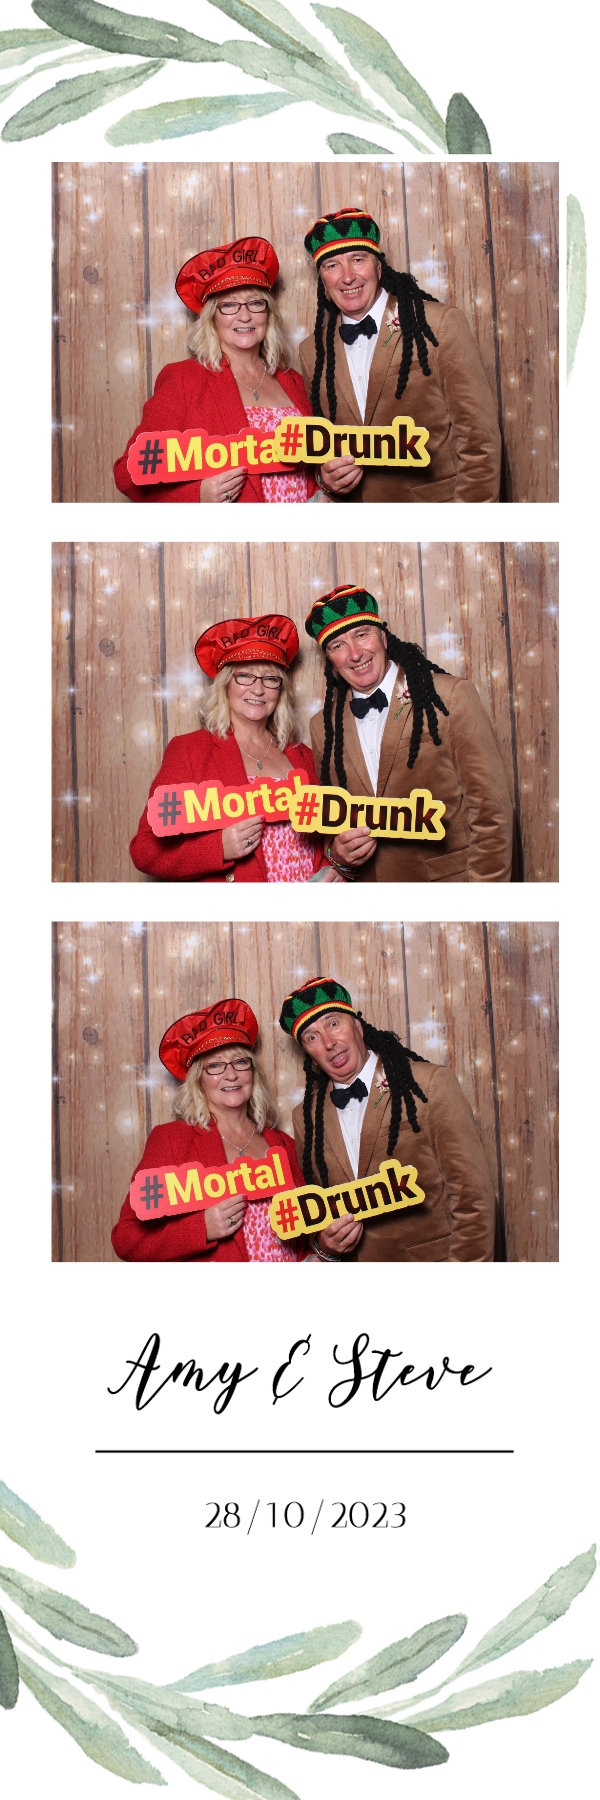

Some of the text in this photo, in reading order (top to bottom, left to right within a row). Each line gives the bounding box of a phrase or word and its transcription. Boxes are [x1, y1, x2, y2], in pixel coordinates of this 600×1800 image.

[198, 249, 259, 281] BAD GIRL
[138, 434, 281, 475] #Morta
[279, 424, 423, 460] #Drunk
[220, 624, 282, 648] BAD GIRL
[294, 792, 439, 833] #Drunk
[180, 1012, 239, 1045] BAD GIRL
[139, 1153, 287, 1210] #Mortal
[275, 1167, 417, 1233] #Drunk
